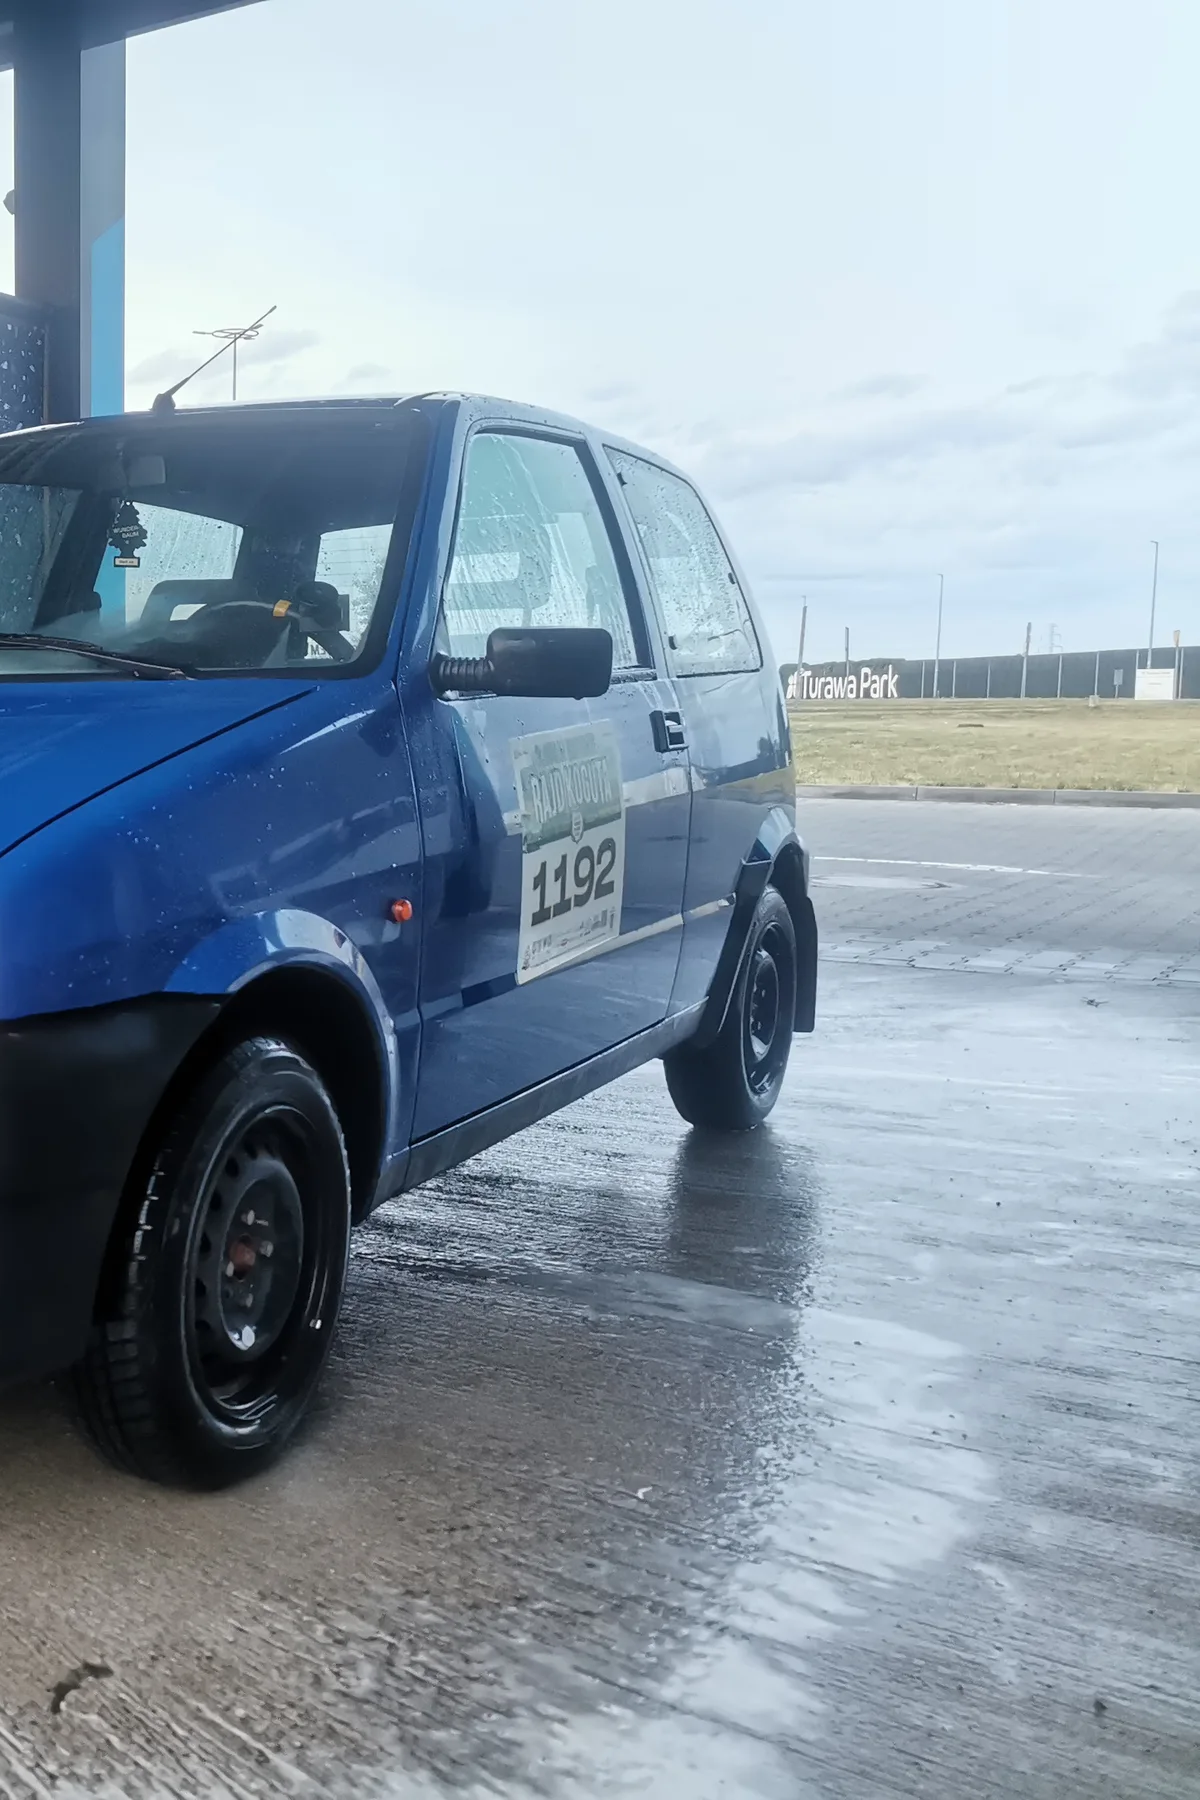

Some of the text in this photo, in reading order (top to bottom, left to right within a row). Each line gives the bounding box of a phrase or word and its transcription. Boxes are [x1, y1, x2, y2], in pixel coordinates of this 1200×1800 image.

[801, 664, 899, 699] Turawa Park
[531, 837, 616, 928] 1192
